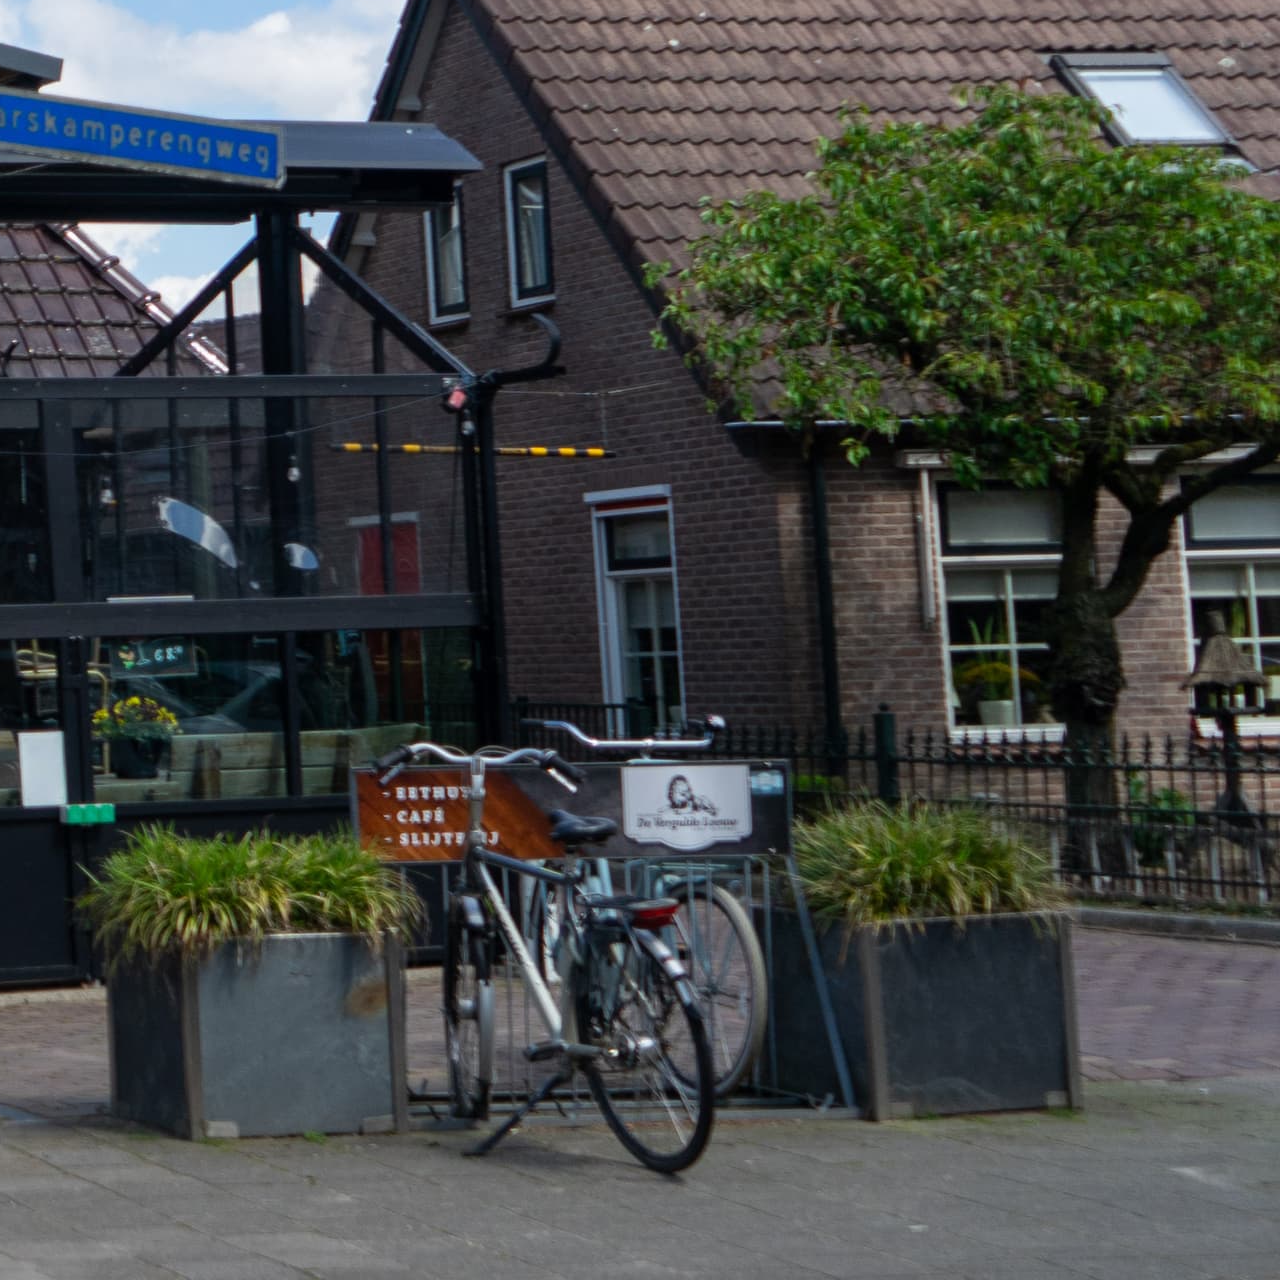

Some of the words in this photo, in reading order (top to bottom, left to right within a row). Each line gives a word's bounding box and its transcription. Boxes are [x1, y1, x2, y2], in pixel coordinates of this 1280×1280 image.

[395, 786, 486, 800] EETHUY
[396, 806, 445, 824] CAFÉ
[399, 831, 499, 846] SLIJTEIJ
